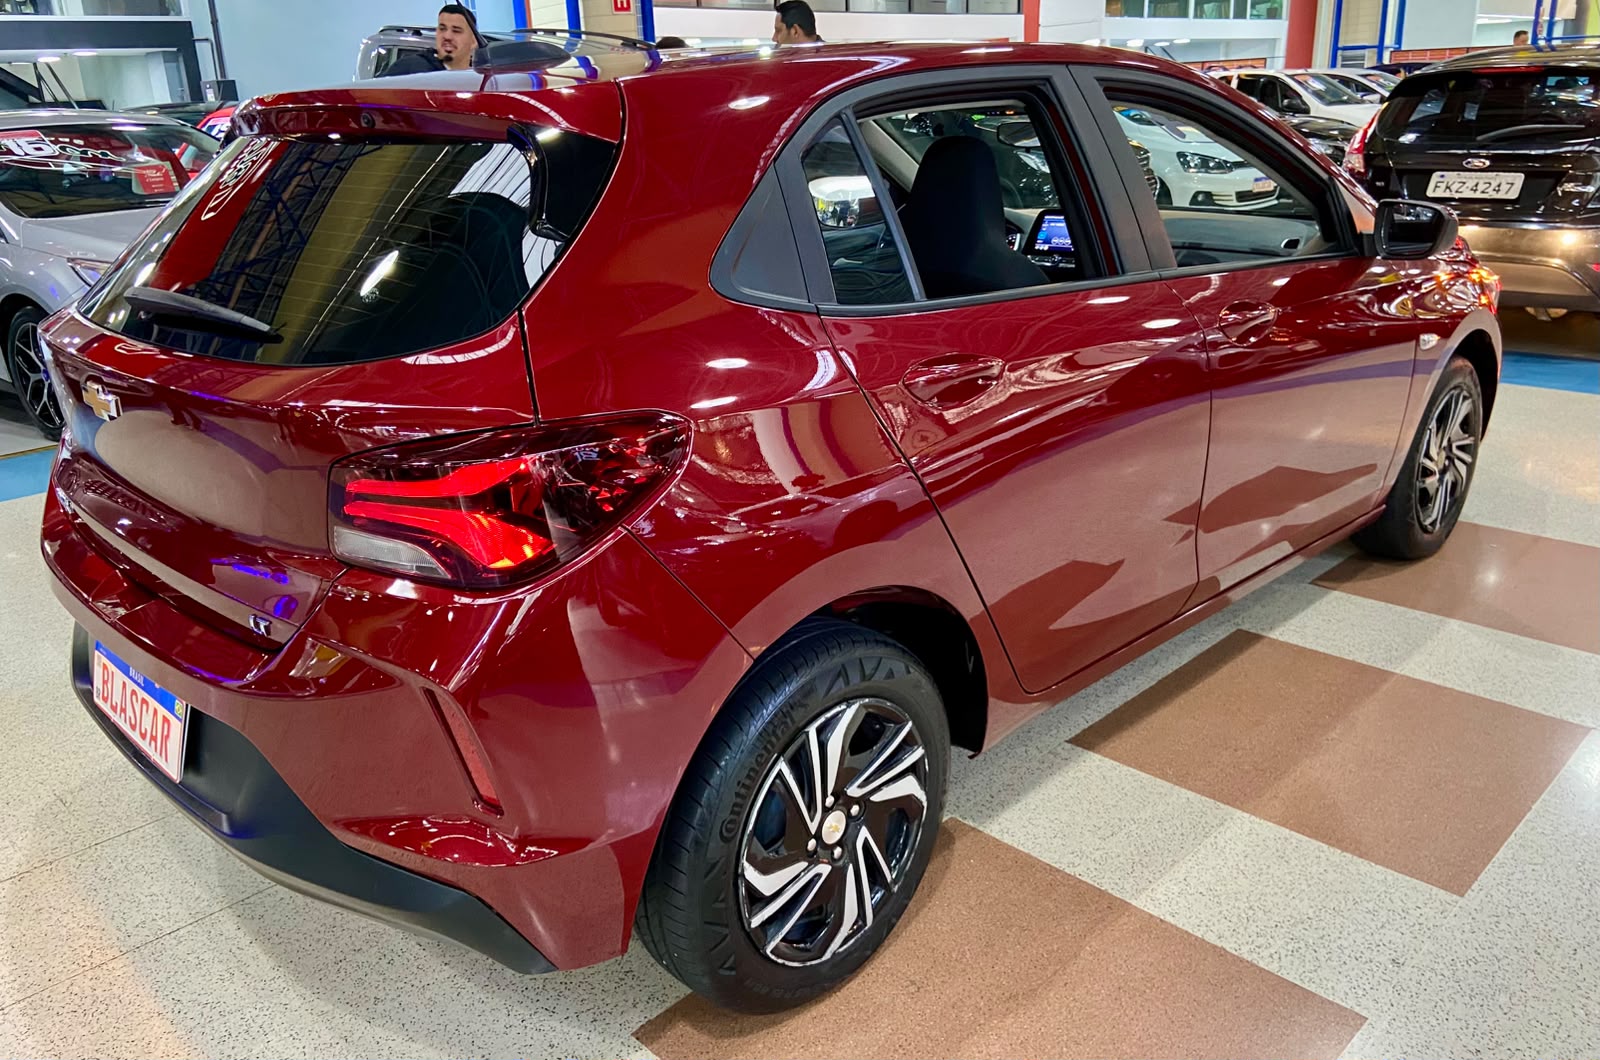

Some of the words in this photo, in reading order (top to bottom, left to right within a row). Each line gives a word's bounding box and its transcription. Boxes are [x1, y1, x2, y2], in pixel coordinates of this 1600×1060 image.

[248, 614, 272, 637] LT
[101, 662, 171, 763] BLASCAR
[720, 706, 798, 843] Continental
